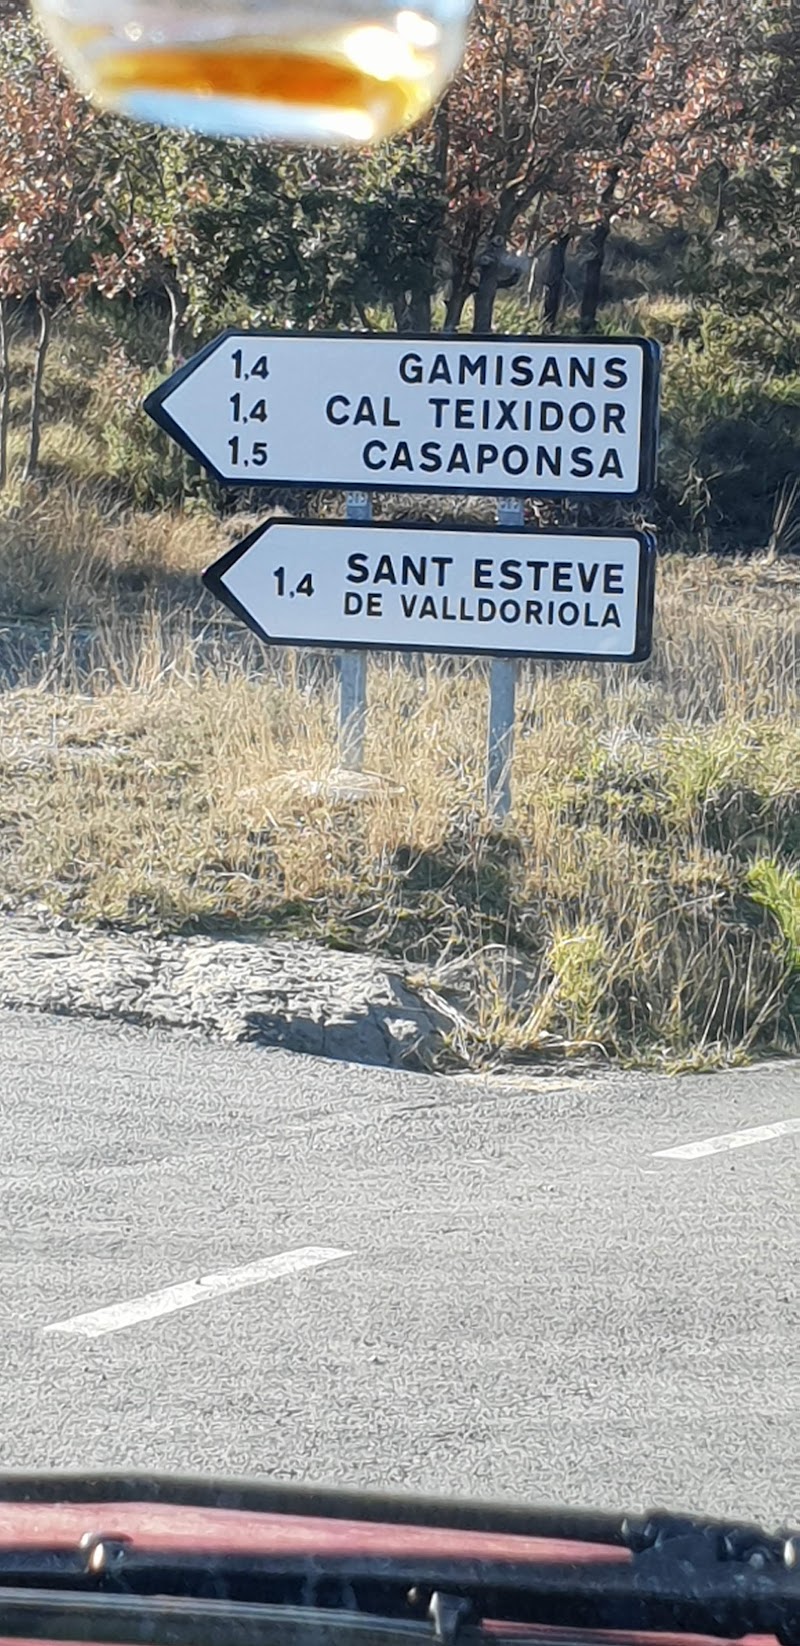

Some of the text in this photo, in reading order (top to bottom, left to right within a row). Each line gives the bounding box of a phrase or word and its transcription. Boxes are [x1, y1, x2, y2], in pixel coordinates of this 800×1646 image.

[231, 348, 628, 389] 1,4 GAMISANS
[229, 392, 626, 434] 1,4 CAL TEIXIDOR
[227, 435, 624, 479] 1,5 CASAPONSA
[273, 566, 315, 598] 1,4
[345, 552, 624, 595] SANT ESTEVE
[343, 591, 621, 628] DE VALLDORIOLA
